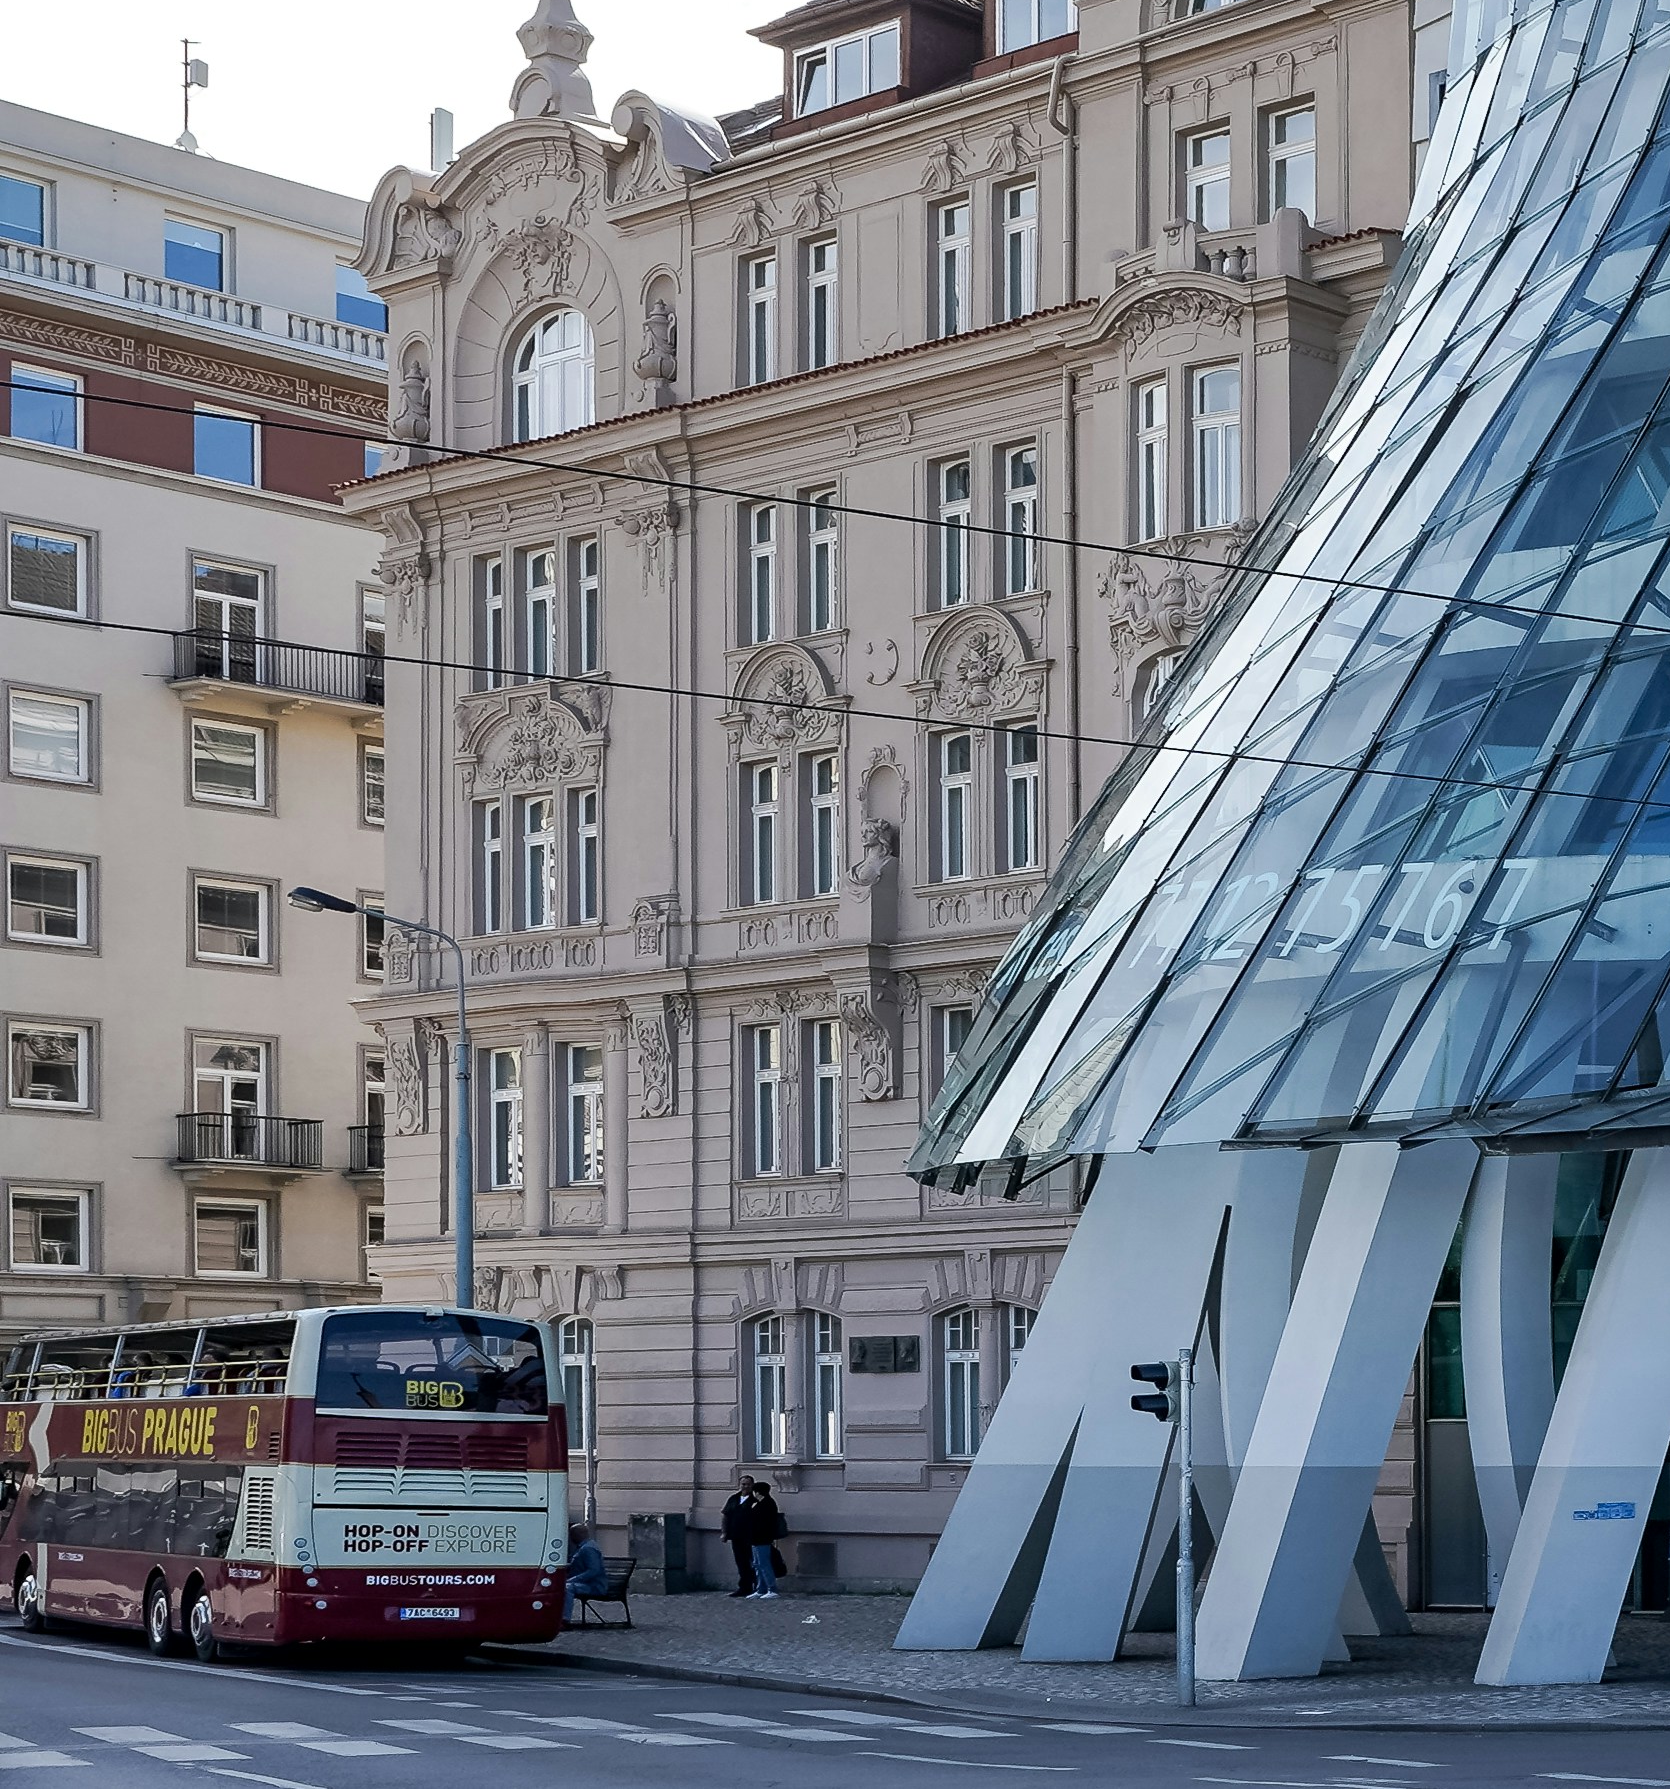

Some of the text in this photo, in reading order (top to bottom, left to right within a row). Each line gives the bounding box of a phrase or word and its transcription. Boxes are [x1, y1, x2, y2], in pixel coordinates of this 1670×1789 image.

[406, 1380, 439, 1394] BIG
[406, 1394, 439, 1407] BUS
[141, 1406, 218, 1455] PRAGUE
[344, 1524, 517, 1539] HOP-ON DISCOVER
[343, 1539, 517, 1554] HOP-OFF EXPLORE
[366, 1575, 496, 1586] BIGBUSTOURS.COM
